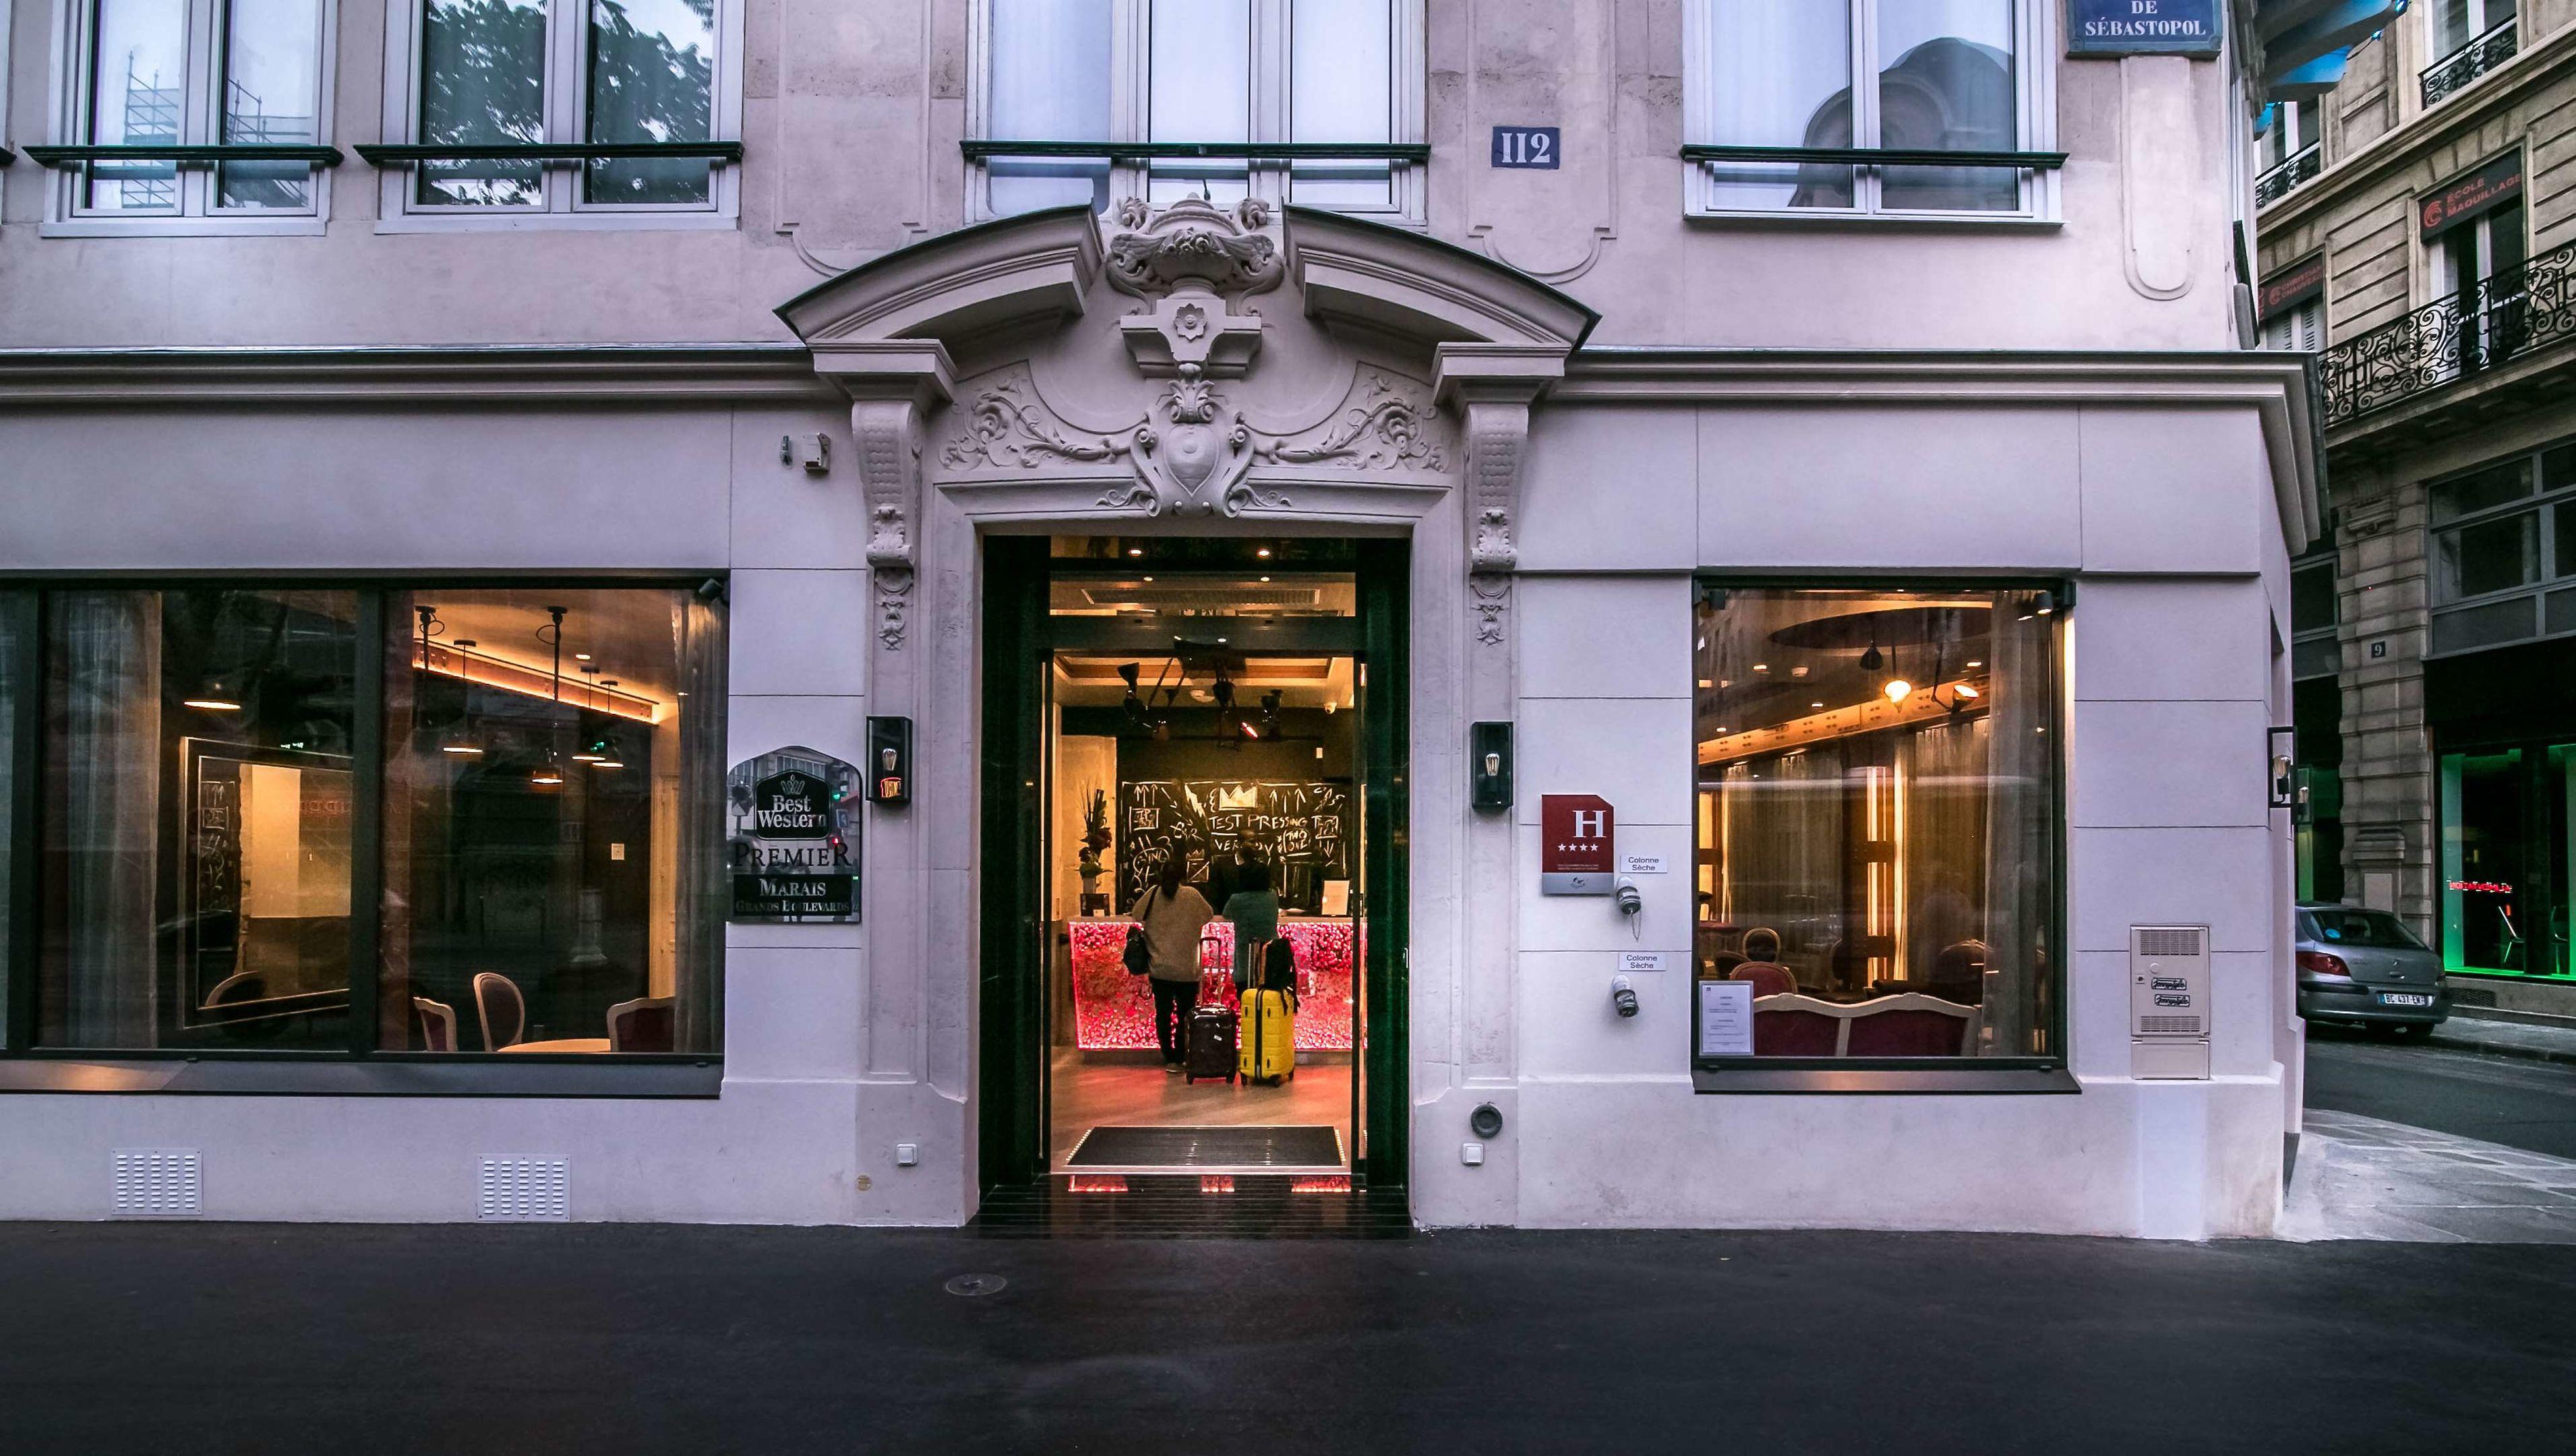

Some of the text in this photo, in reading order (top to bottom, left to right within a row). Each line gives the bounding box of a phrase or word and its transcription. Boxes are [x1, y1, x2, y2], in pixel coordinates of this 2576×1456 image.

[2131, 0, 2158, 14] DE
[2085, 16, 2207, 36] SÉBASTOPOL
[1501, 133, 1551, 163] 112
[2447, 173, 2522, 217] MAQUILLAGE
[2374, 644, 2383, 656] 9
[773, 795, 811, 812] Best
[757, 810, 827, 828] Western
[1209, 814, 1243, 830] TEST
[1248, 814, 1307, 830] PRESSING
[1572, 810, 1607, 838] H
[734, 843, 852, 867] PREMIER
[759, 878, 827, 897] MARAIS
